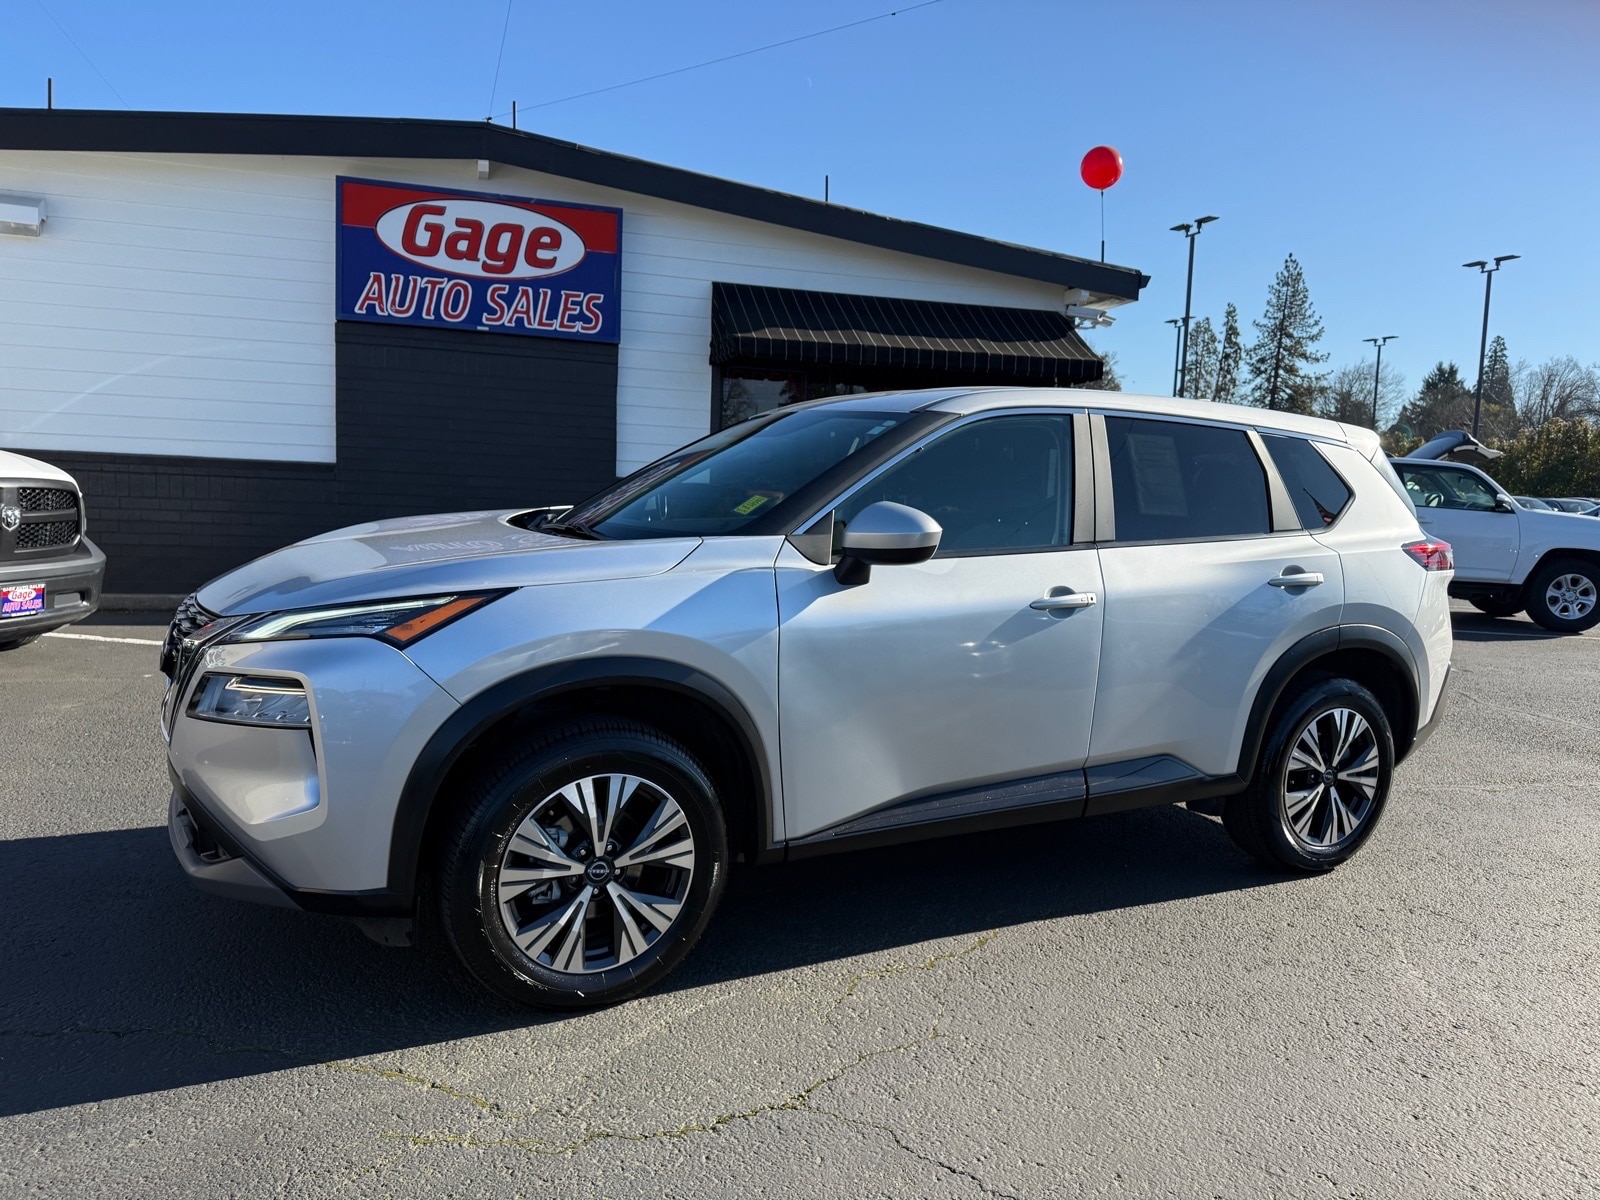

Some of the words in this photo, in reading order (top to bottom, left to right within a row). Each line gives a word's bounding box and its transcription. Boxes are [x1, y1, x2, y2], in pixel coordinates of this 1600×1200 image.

[401, 204, 562, 274] Gage
[354, 272, 472, 322] AUTO
[482, 283, 604, 334] SALES
[12, 590, 32, 600] Gage
